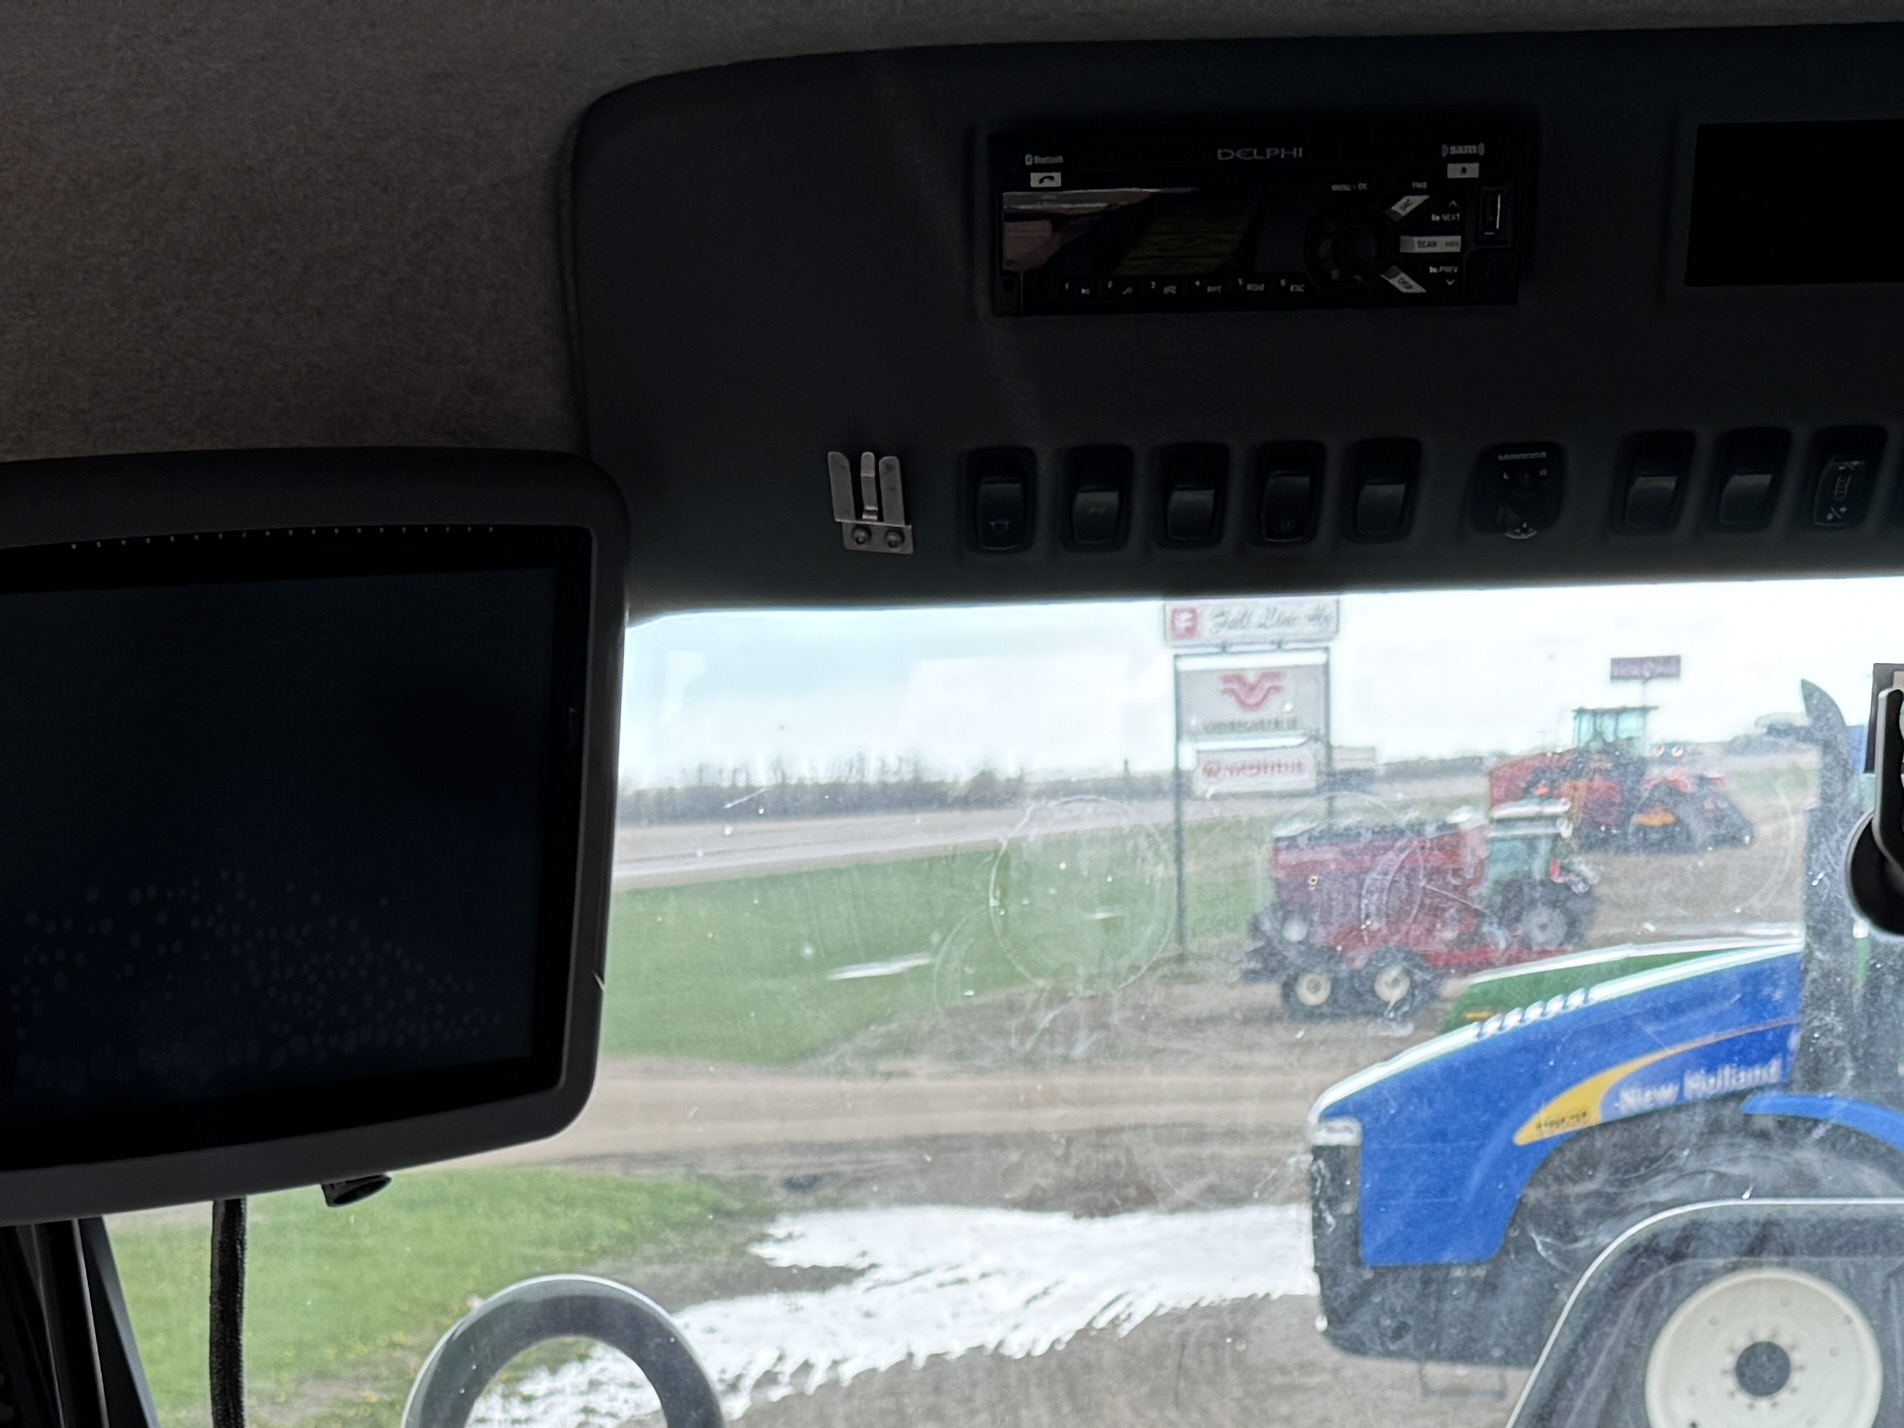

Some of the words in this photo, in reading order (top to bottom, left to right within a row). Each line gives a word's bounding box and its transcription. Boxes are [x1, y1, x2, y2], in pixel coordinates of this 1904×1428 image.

[1216, 146, 1304, 161] DELPHI
[1618, 1080, 1680, 1113] New
[1683, 1055, 1783, 1101] Holland
